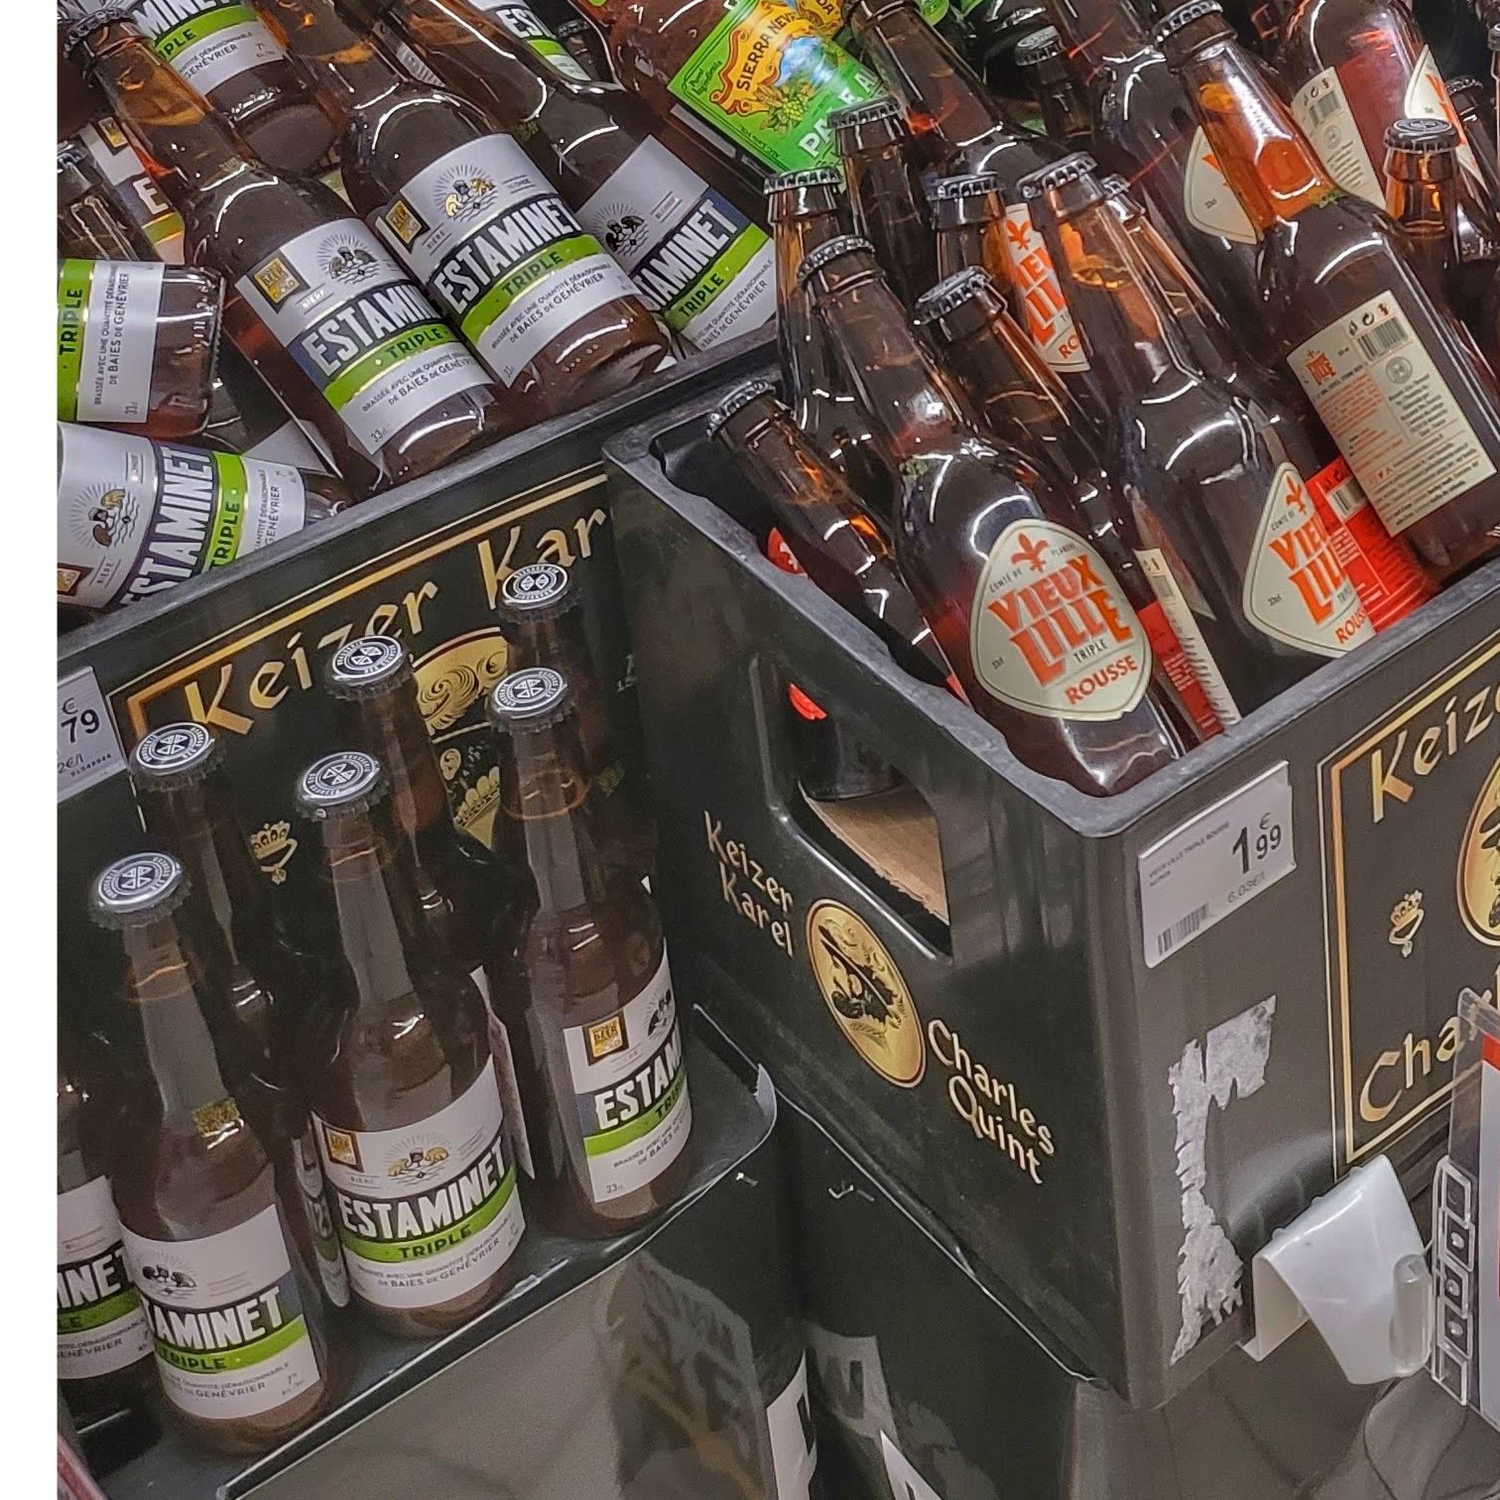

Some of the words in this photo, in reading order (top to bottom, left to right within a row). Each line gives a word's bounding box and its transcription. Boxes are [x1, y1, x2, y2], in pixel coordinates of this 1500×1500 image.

[434, 192, 584, 310] ESTAMINET
[504, 249, 567, 295] TRIPLE
[681, 268, 724, 324] TRIPLE
[384, 325, 448, 362] TRIPLE
[988, 554, 1104, 635] VIEUX
[1009, 589, 1135, 690] LILLE
[1063, 655, 1139, 708] ROUSSE
[1073, 638, 1108, 666] TRIPLE
[703, 810, 793, 912] Keizer
[720, 863, 793, 956] Karel
[928, 1020, 1054, 1156] Charles
[949, 1075, 1042, 1184] Quint
[338, 1136, 506, 1243] ESTAMINET
[397, 1224, 472, 1263] TRIPLE
